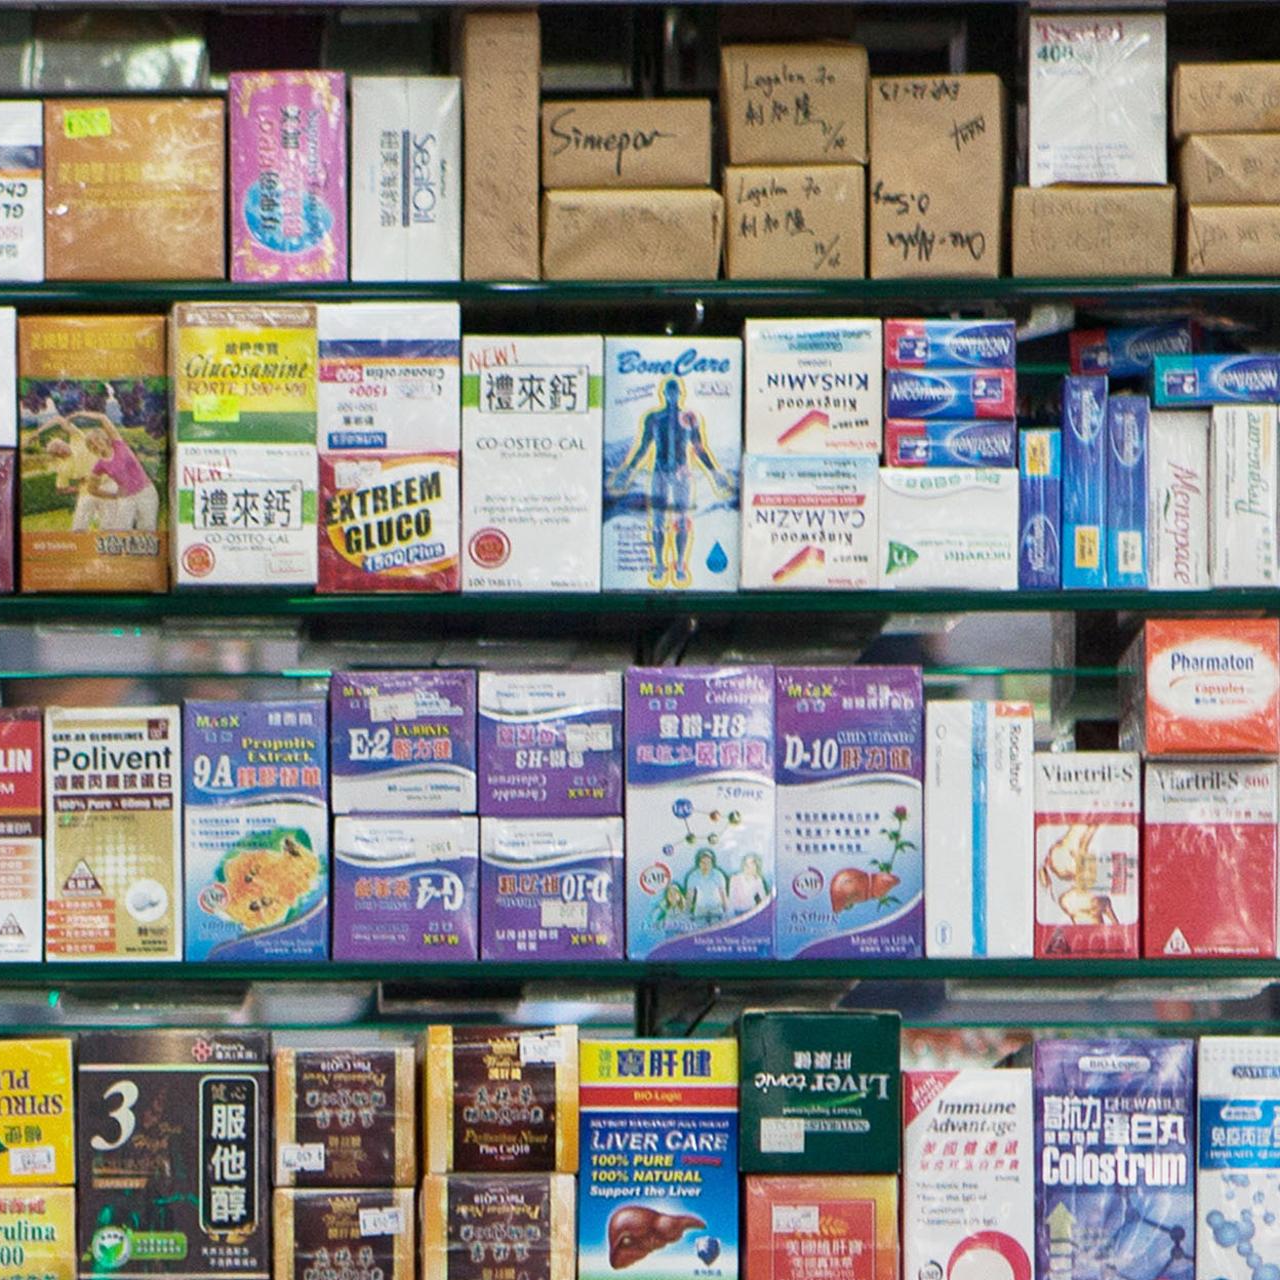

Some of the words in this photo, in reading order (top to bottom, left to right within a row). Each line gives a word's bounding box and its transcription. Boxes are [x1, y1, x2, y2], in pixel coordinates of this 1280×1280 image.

[185, 354, 309, 383] Glucosamine
[182, 458, 232, 485] NEW!
[1170, 460, 1202, 586] Menopace
[1171, 652, 1254, 674] Pharmaton
[53, 745, 173, 772] Polivent
[783, 734, 838, 772] D-10
[193, 753, 235, 790] 9A
[817, 1072, 891, 1101] Liver
[938, 1101, 1016, 1117] Immune
[590, 1128, 660, 1152] LIVER
[665, 1129, 729, 1152] CARE
[928, 1118, 1018, 1138] Advantage
[590, 1153, 629, 1167] 100%
[632, 1153, 673, 1167] PURE
[1042, 1152, 1188, 1188] Colostrum
[590, 1169, 629, 1183] 100%
[632, 1169, 702, 1183] NATURAL
[589, 1186, 632, 1200] Support
[636, 1186, 656, 1198] the
[660, 1186, 702, 1198] Liver
